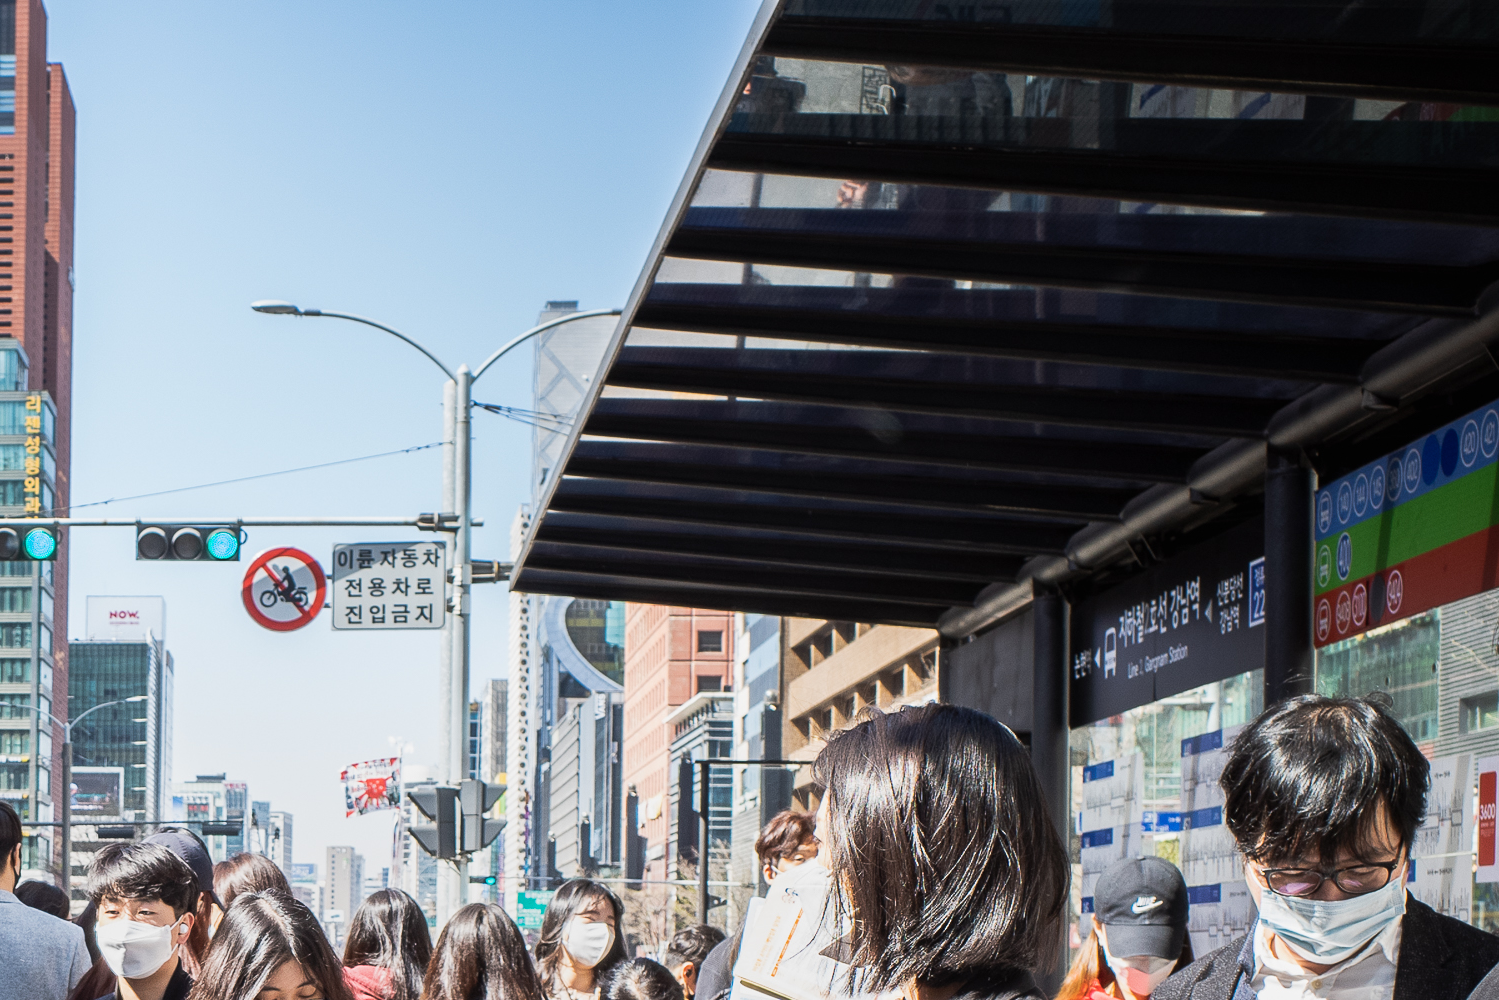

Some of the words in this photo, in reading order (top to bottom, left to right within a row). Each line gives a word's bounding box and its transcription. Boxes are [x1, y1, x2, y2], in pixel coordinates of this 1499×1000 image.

[24, 395, 41, 519] 리젠성형외과
[338, 548, 441, 569] 이륜자동차
[345, 577, 434, 597] 전용차로
[345, 603, 433, 624] 진입금지
[1169, 576, 1200, 630] 강남역
[1169, 643, 1188, 664] Station
